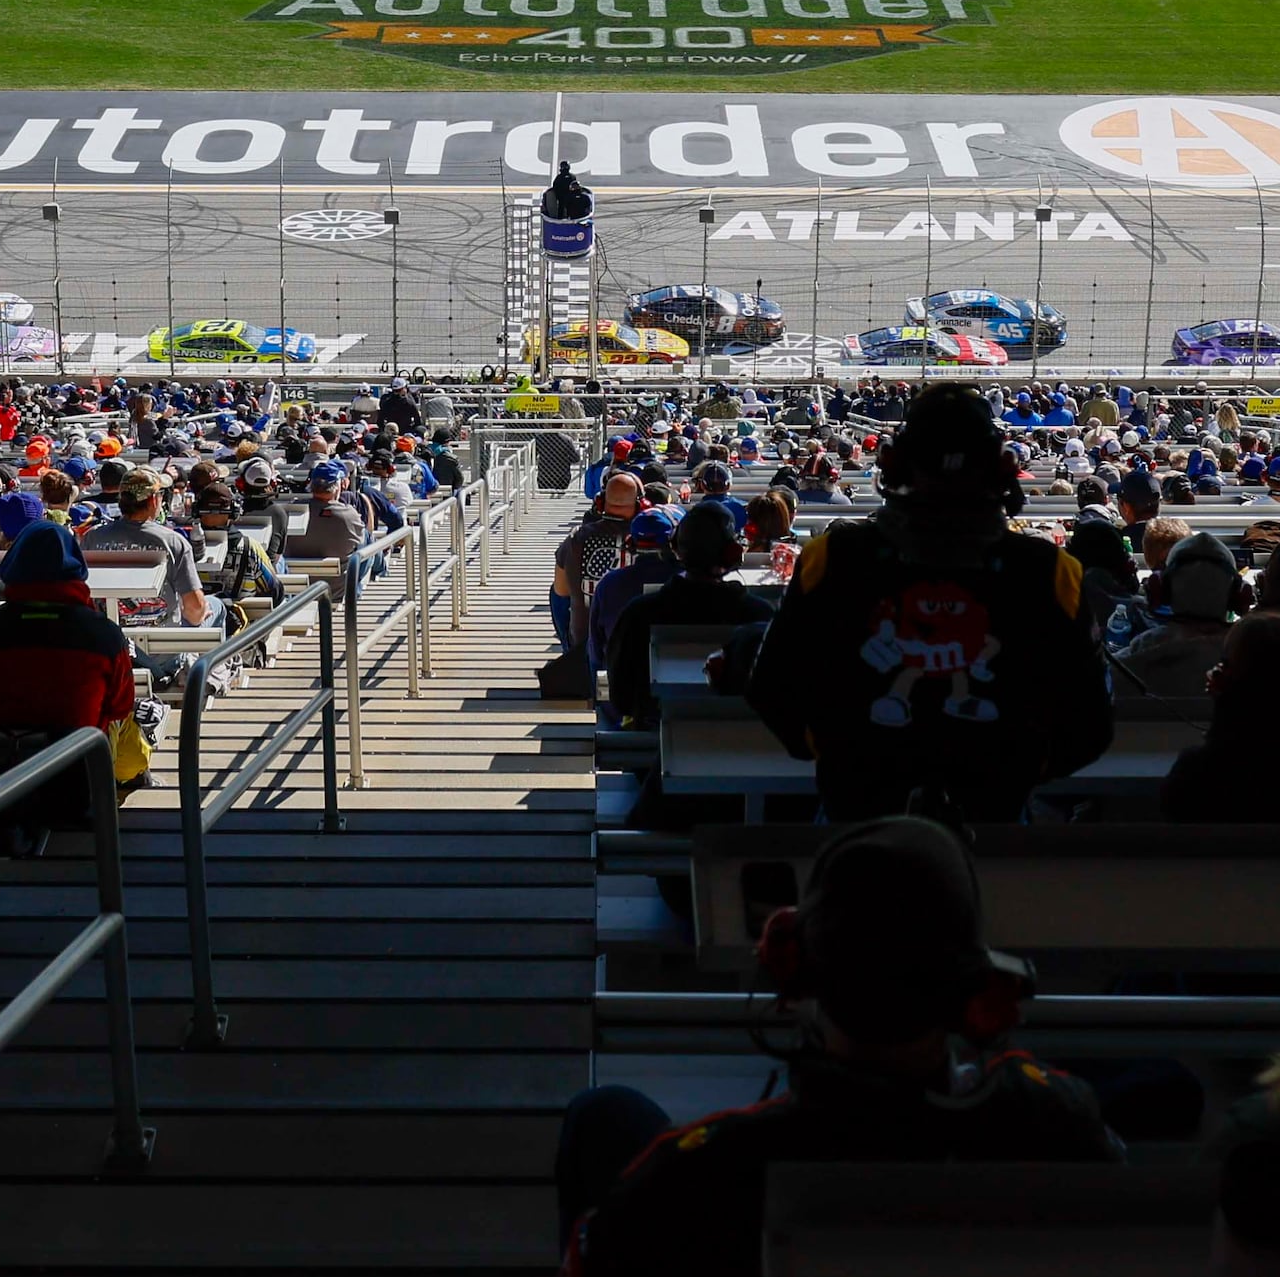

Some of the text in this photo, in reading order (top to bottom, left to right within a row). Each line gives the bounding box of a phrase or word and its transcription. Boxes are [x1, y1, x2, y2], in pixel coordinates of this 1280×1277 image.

[517, 25, 748, 50] 400
[603, 55, 772, 65] SPEEDWAY
[707, 209, 1135, 242] ATLANTA
[719, 315, 737, 333] 8
[997, 323, 1025, 338] 45
[162, 347, 225, 360] MENARDS
[1235, 353, 1269, 365] xfinity
[283, 389, 305, 399] 146
[786, 388, 807, 398] 146
